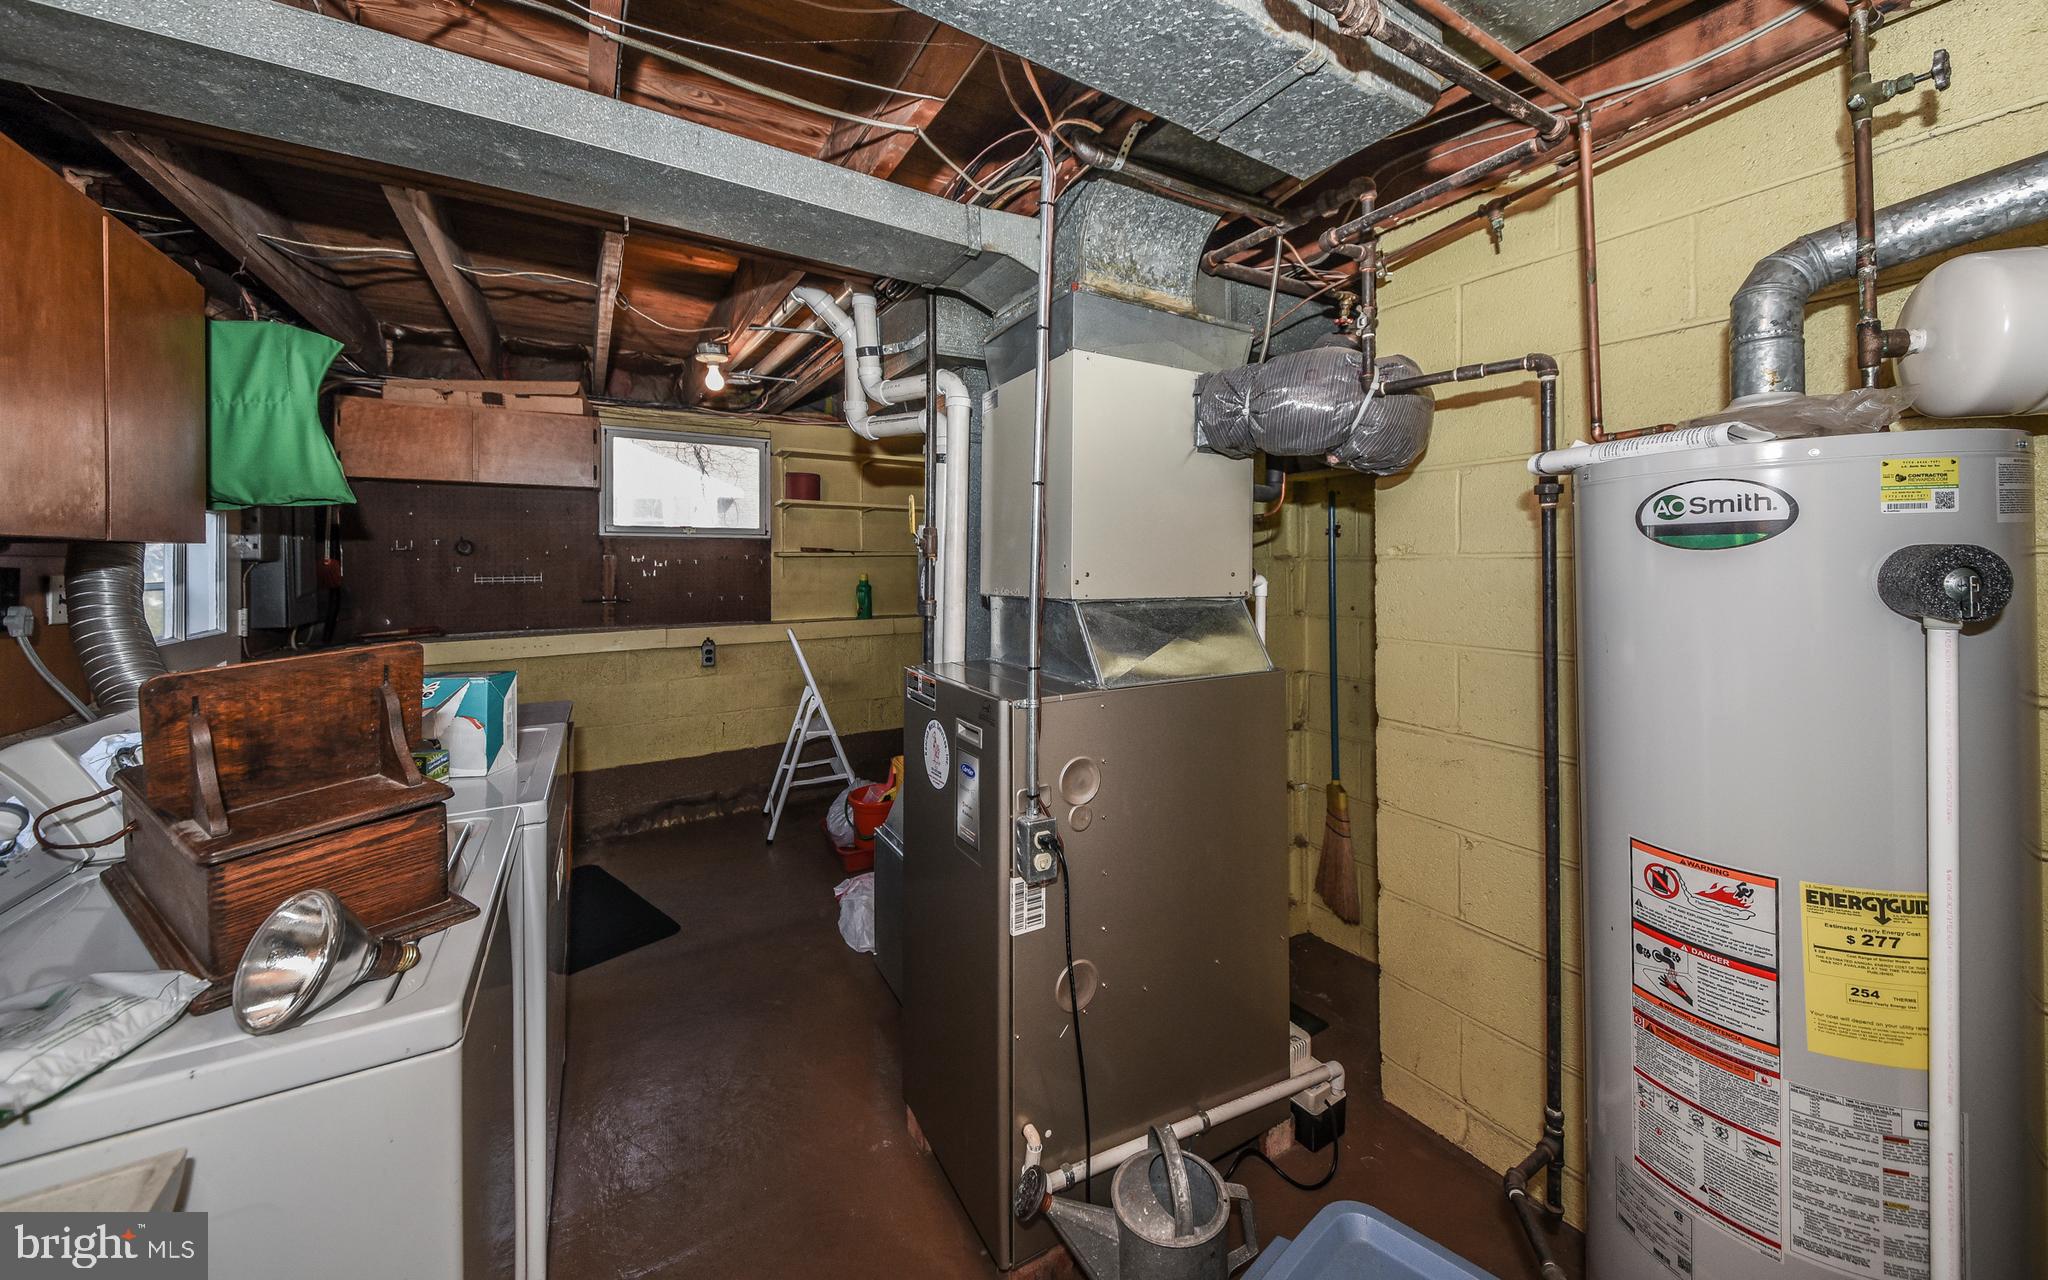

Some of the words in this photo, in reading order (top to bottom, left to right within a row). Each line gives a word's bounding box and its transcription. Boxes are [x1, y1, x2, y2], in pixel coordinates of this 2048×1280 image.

[1654, 497, 1688, 517] AO
[1686, 860, 1730, 877] WARNING
[1806, 889, 1929, 922] ENERGYGUID
[1825, 923, 1858, 932] Estimated
[1860, 927, 1881, 935] Yearly
[1882, 929, 1905, 937] Energy
[1846, 935, 1856, 945] $
[1861, 934, 1901, 949] 277
[1691, 948, 1731, 966] DANGER
[1850, 987, 1880, 999] 254
[1851, 1018, 1874, 1026] depend
[1696, 1020, 1743, 1042] ADVERTENCIA
